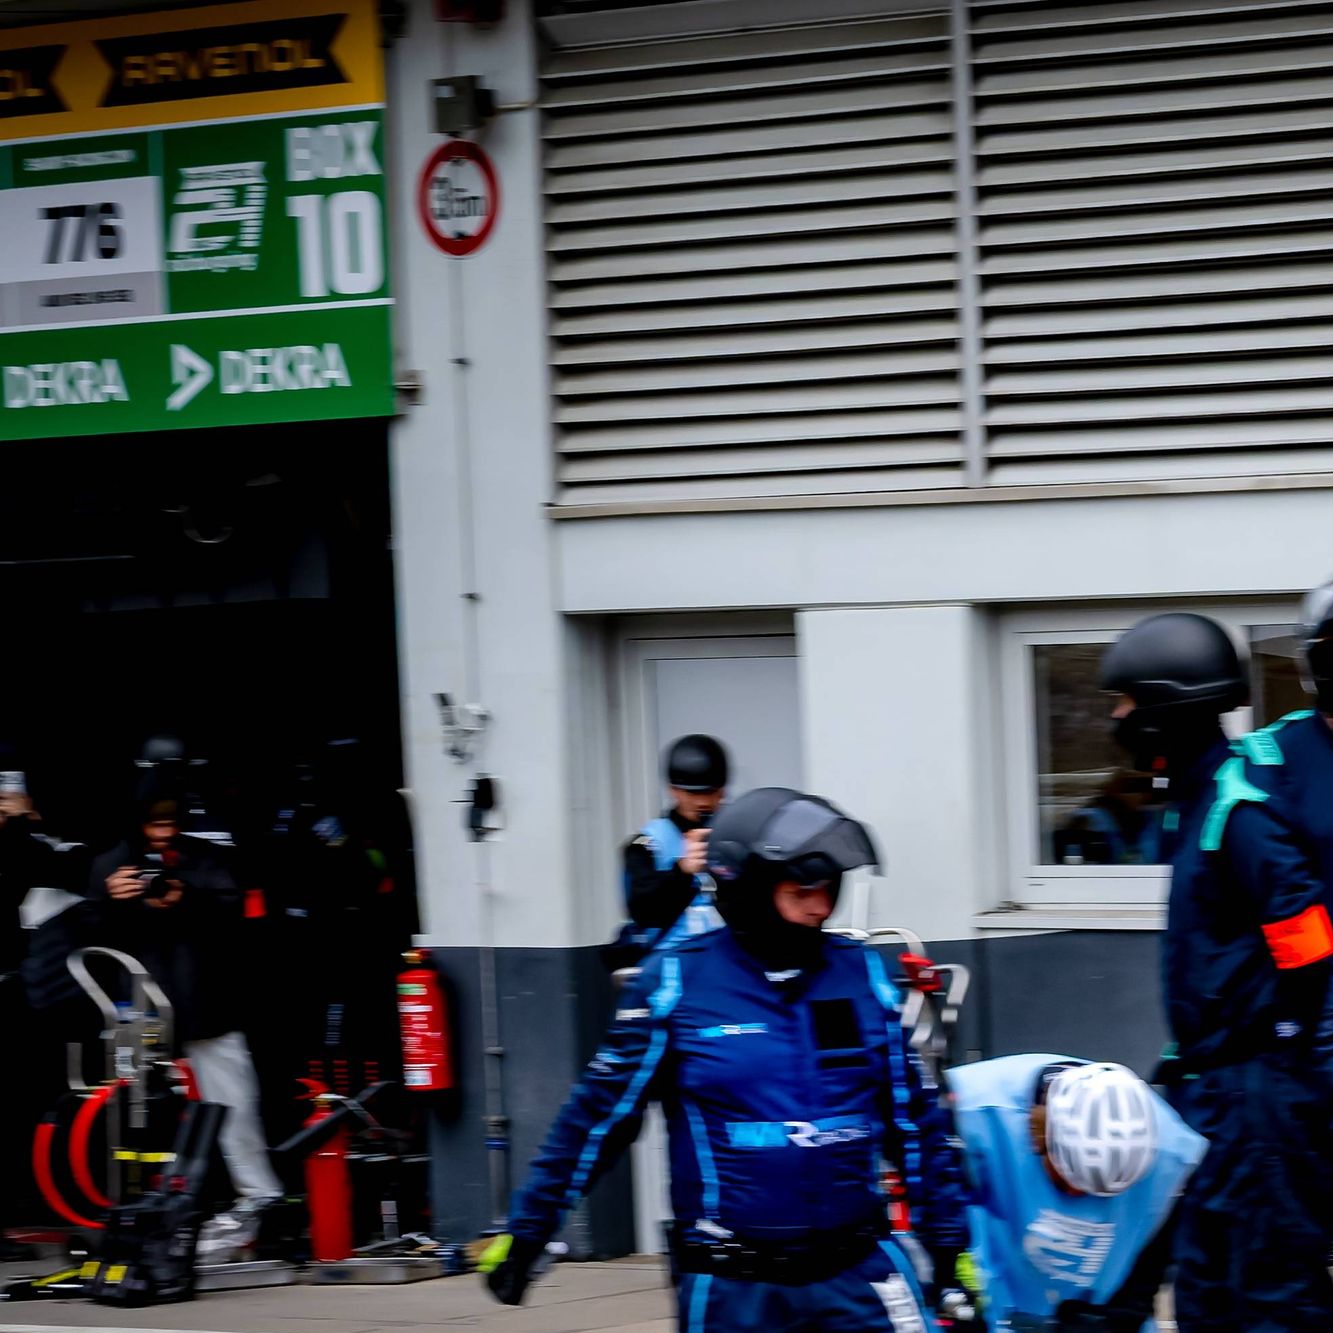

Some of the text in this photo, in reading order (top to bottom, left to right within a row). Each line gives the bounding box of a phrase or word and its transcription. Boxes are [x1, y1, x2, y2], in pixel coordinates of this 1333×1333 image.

[122, 39, 326, 88] RAVENOL
[286, 121, 382, 181] BOX
[38, 202, 126, 265] 776
[286, 190, 384, 297] 10
[2, 359, 130, 408] DEKRA
[219, 343, 352, 394] DEKRA
